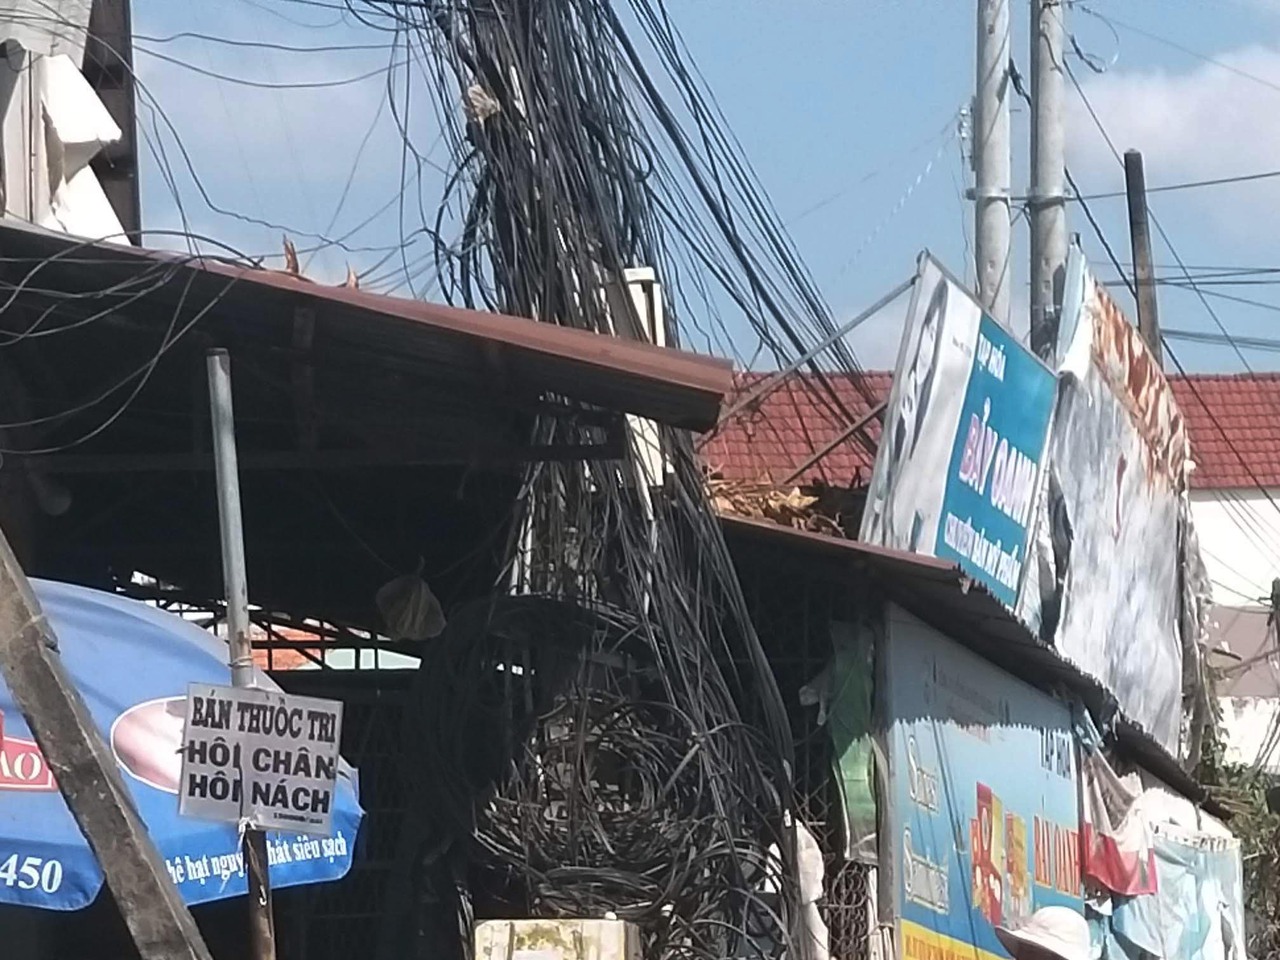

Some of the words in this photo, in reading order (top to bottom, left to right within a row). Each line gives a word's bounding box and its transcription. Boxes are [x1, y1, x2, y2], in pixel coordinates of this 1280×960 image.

[191, 689, 232, 730] BÁN
[188, 736, 241, 768] HÔI
[252, 747, 335, 779] CHÂN
[188, 770, 242, 802] HÔI
[251, 779, 330, 813] NÁCH
[322, 831, 347, 864] sạch
